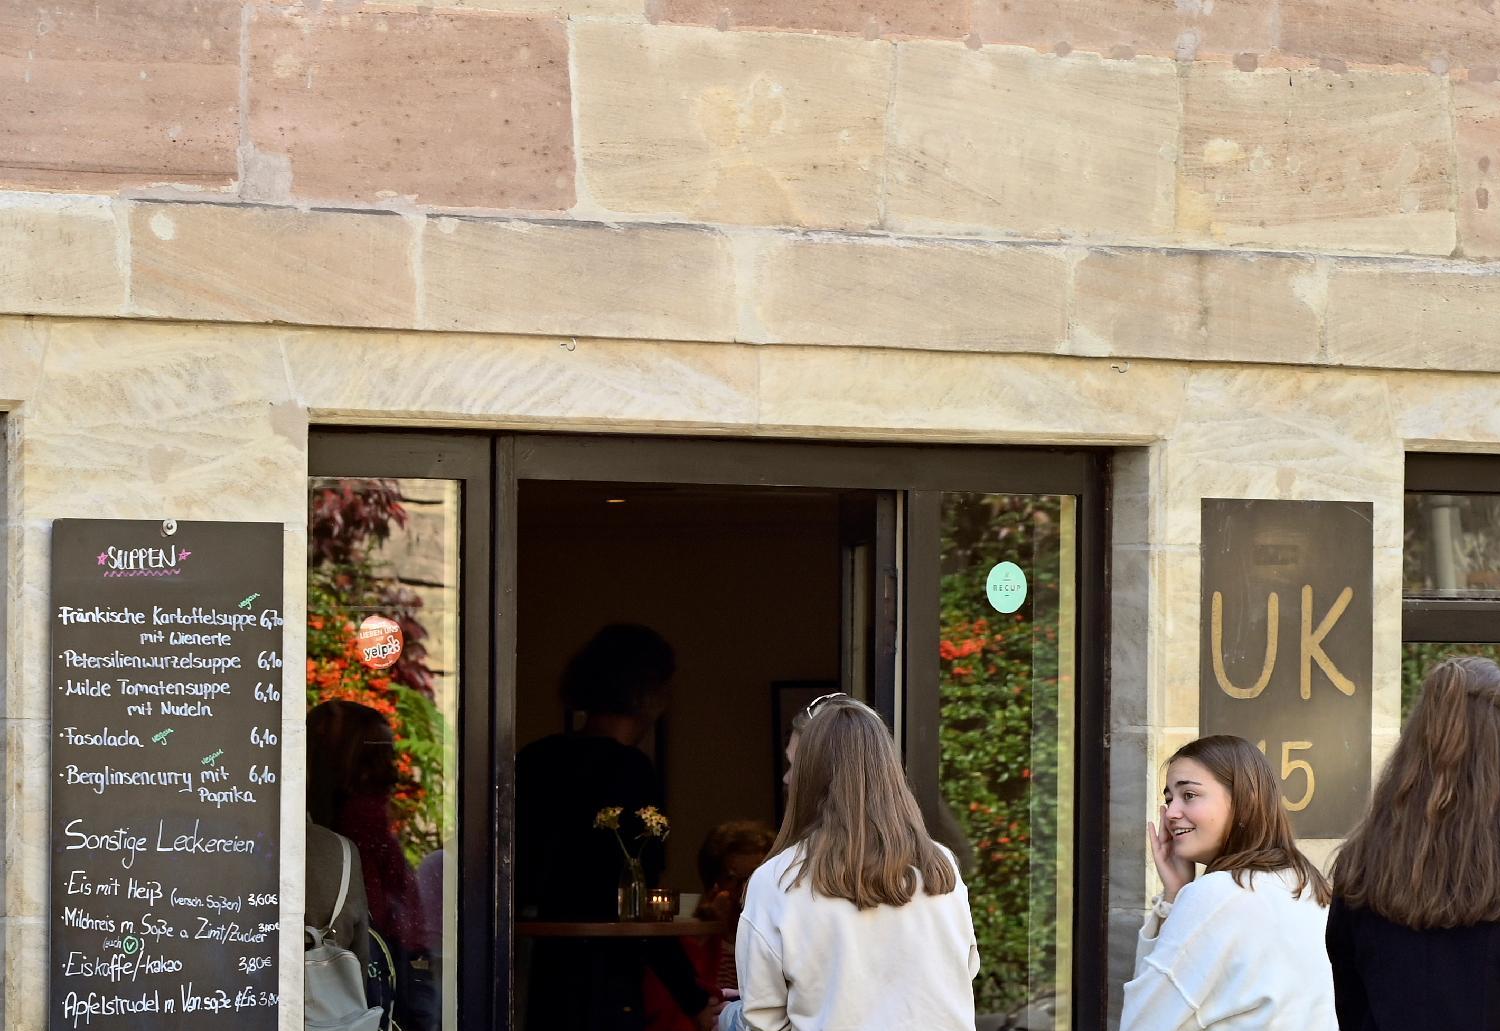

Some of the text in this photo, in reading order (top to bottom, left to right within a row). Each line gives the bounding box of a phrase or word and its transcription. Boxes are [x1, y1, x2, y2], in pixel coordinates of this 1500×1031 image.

[107, 545, 176, 569] SUPPEN
[60, 606, 145, 626] Fränkische
[153, 605, 257, 631] Kartoffelsuppe
[140, 629, 164, 645] mit
[1211, 584, 1356, 700] UK
[64, 649, 283, 675] Petersilienwurzelsuppe 6,10
[364, 642, 389, 661] yelp
[65, 678, 280, 702] Milde Tomatensuppe 6,10
[127, 701, 213, 717] mit Nudeln
[64, 727, 144, 748] Fasolada
[250, 726, 278, 748] 6,10
[66, 764, 276, 794] Berglinsencurry mit 6,10
[197, 785, 257, 808] Paprika
[64, 818, 254, 869] Sonstige Leckereien
[67, 870, 92, 895] Eis
[96, 877, 121, 896] mit
[127, 878, 164, 907] Heiß
[64, 906, 116, 933] Milchreis
[140, 913, 174, 944] Soße
[194, 916, 268, 945] Zimt/Zucker
[238, 955, 273, 975] 3,80€
[64, 990, 160, 1029] Apfelstrudel
